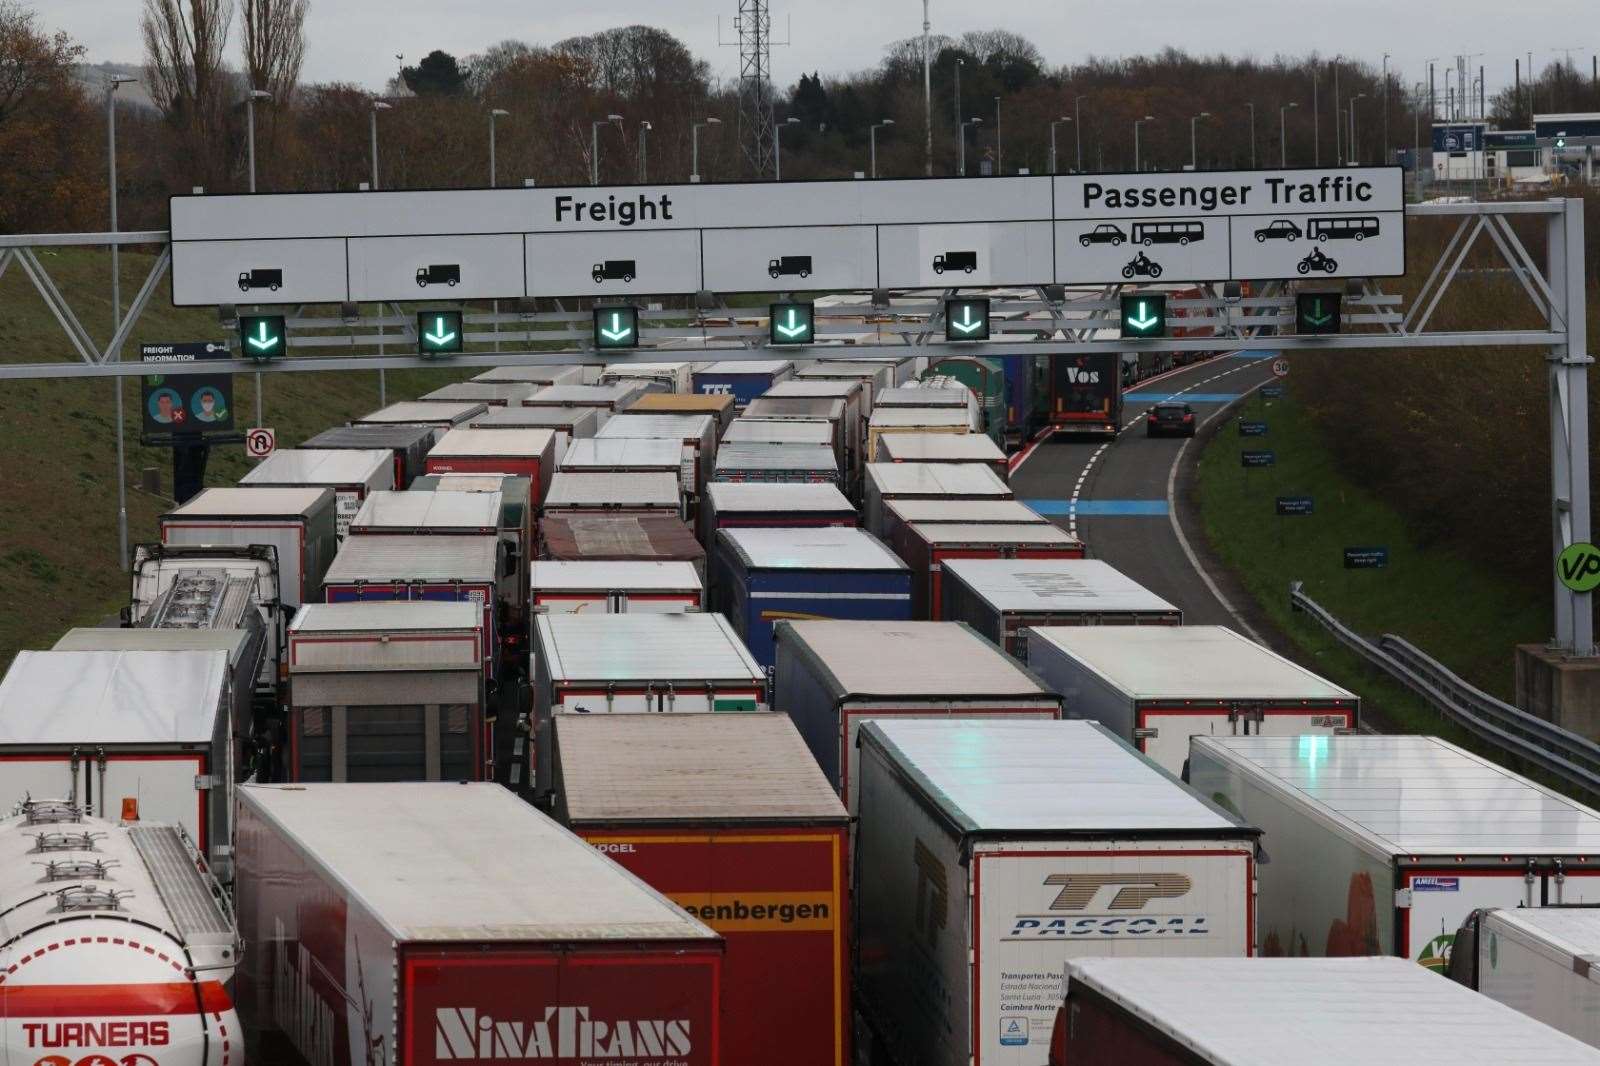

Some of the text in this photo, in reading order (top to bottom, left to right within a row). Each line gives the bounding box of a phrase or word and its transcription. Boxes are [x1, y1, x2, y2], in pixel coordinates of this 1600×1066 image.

[1083, 177, 1373, 211] Passenger Traffic
[555, 194, 673, 226] Freight
[143, 346, 173, 354] FREIGHT
[143, 354, 195, 362] INFORMATION
[1066, 367, 1100, 384] Vos
[1042, 873, 1192, 911] TP
[673, 900, 829, 923] eenbergen
[1010, 917, 1209, 936] PASCOAL
[1001, 972, 1045, 981] Transportes
[1001, 1003, 1056, 1012] Coimbra Norte
[22, 1021, 169, 1048] TURNERS
